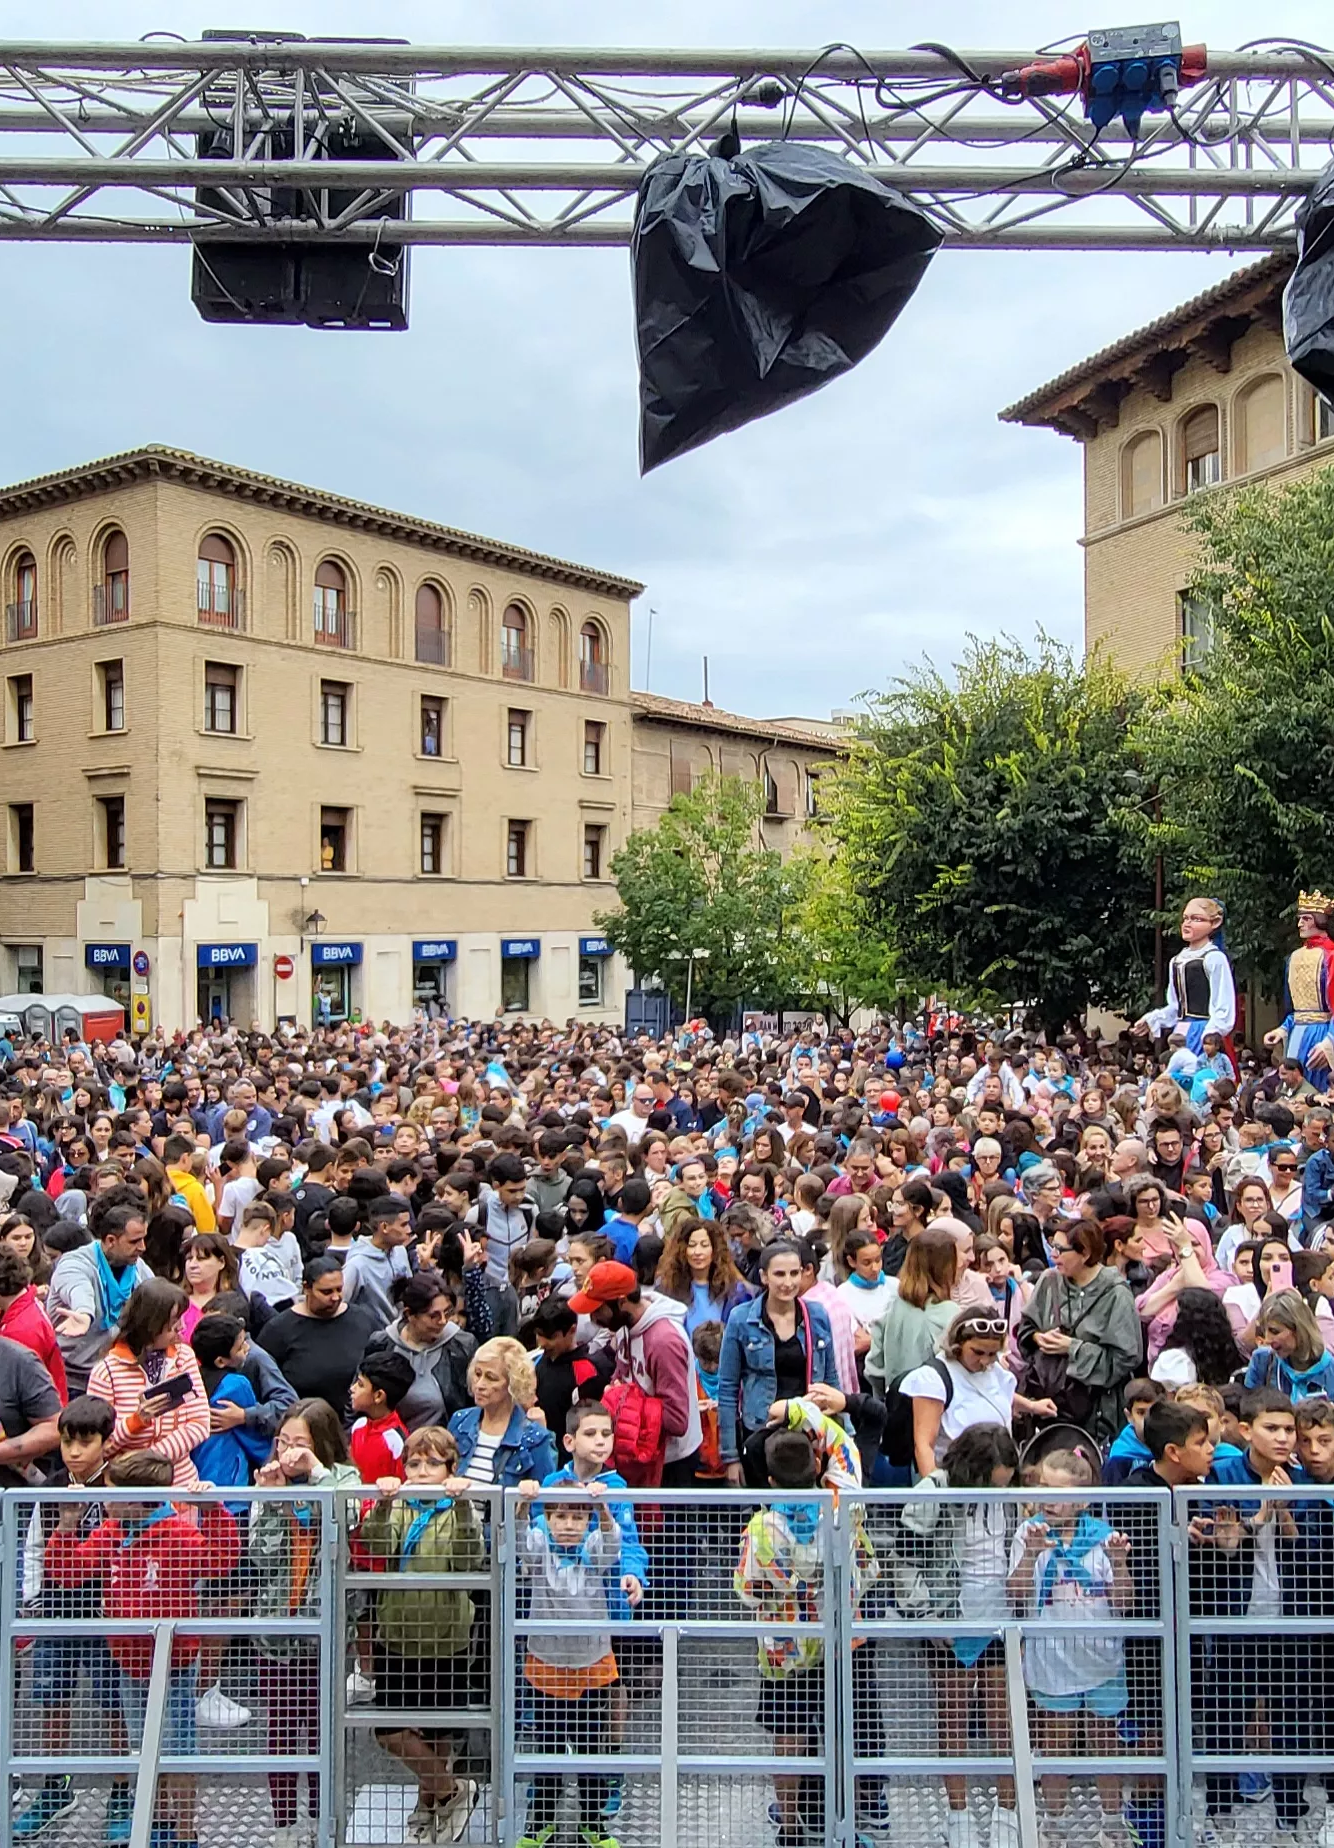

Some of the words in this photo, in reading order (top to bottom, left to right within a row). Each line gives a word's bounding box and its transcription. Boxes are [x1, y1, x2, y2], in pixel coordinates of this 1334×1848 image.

[93, 949, 119, 963] BBVA
[211, 947, 245, 962] BBVA
[323, 946, 353, 960] BBVA
[422, 943, 449, 956] BBVA
